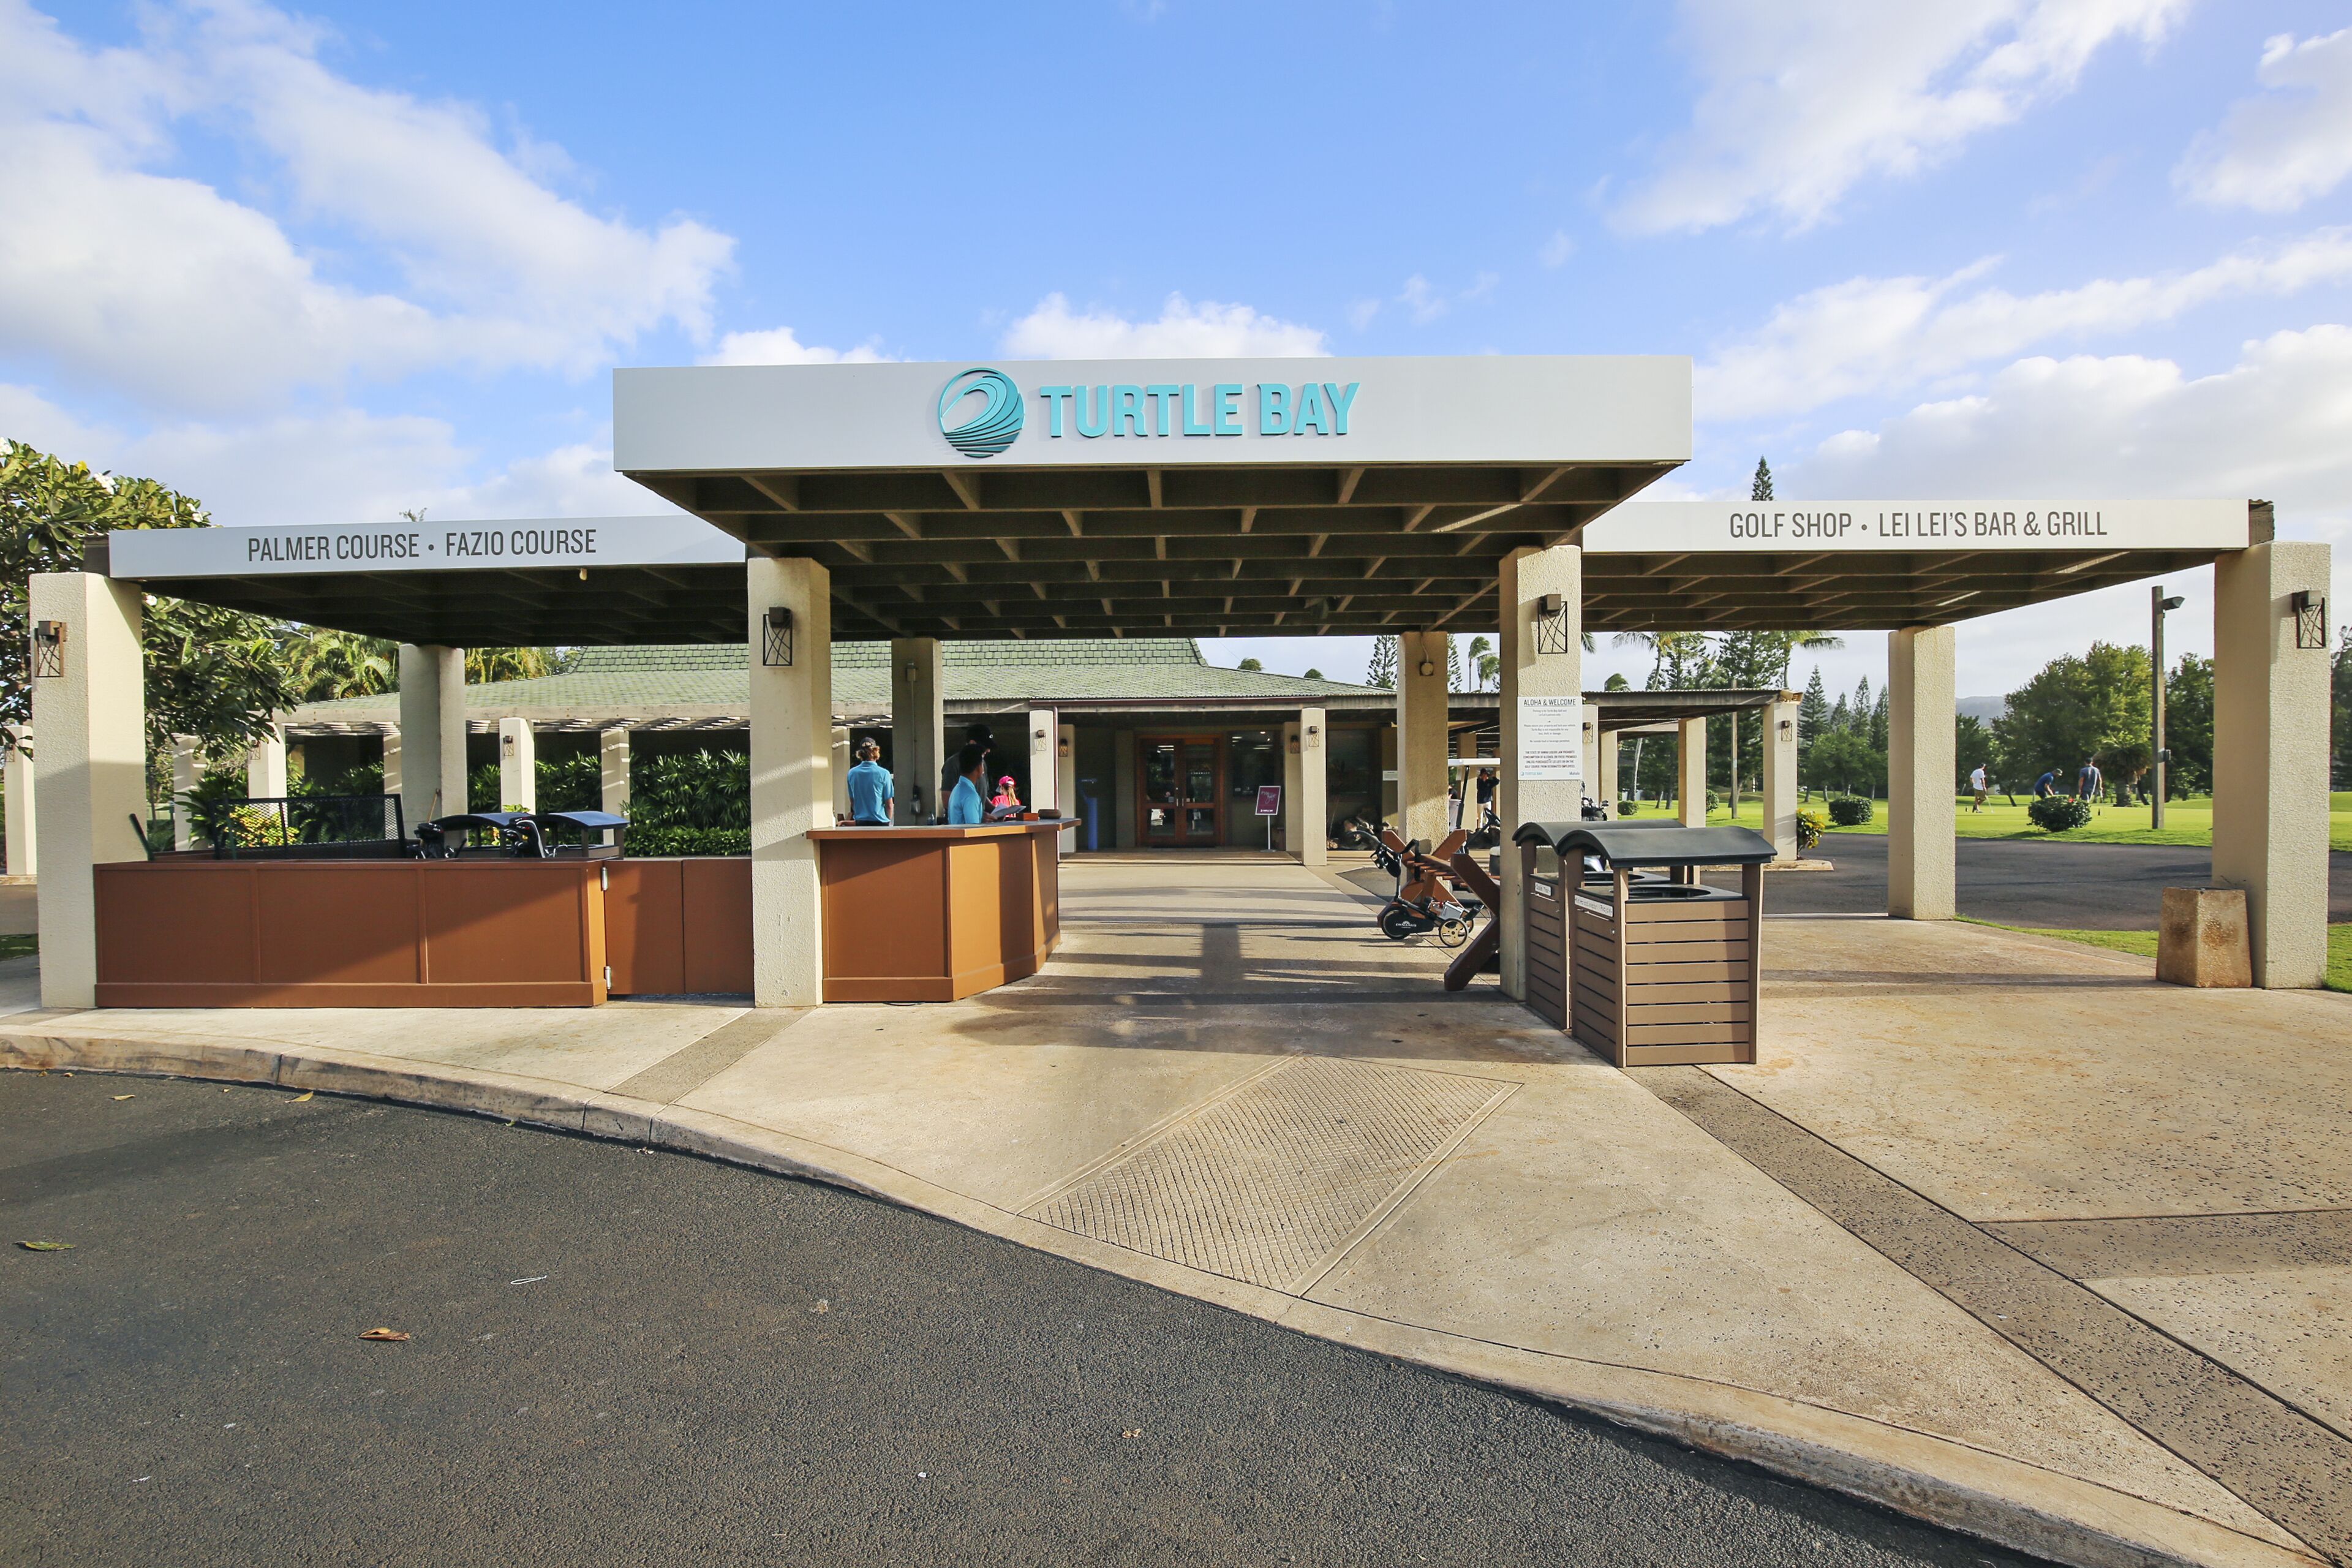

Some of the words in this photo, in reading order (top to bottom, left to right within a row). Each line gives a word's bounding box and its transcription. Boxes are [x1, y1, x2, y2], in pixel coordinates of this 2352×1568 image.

[1040, 383, 1243, 439] TURTLE
[1257, 382, 1360, 436] BAY
[1730, 513, 1785, 538] GOLF
[1792, 513, 1852, 537] SHOP
[1879, 513, 1909, 537] LEI
[1918, 512, 1967, 537] LEI'S
[1975, 512, 2016, 536] BAR
[2024, 511, 2041, 536] &
[2048, 511, 2107, 536] GRILL
[248, 536, 330, 562] PALMER
[336, 533, 420, 560] COURSE
[446, 531, 503, 556] FAZIO
[511, 529, 597, 554] COURSE
